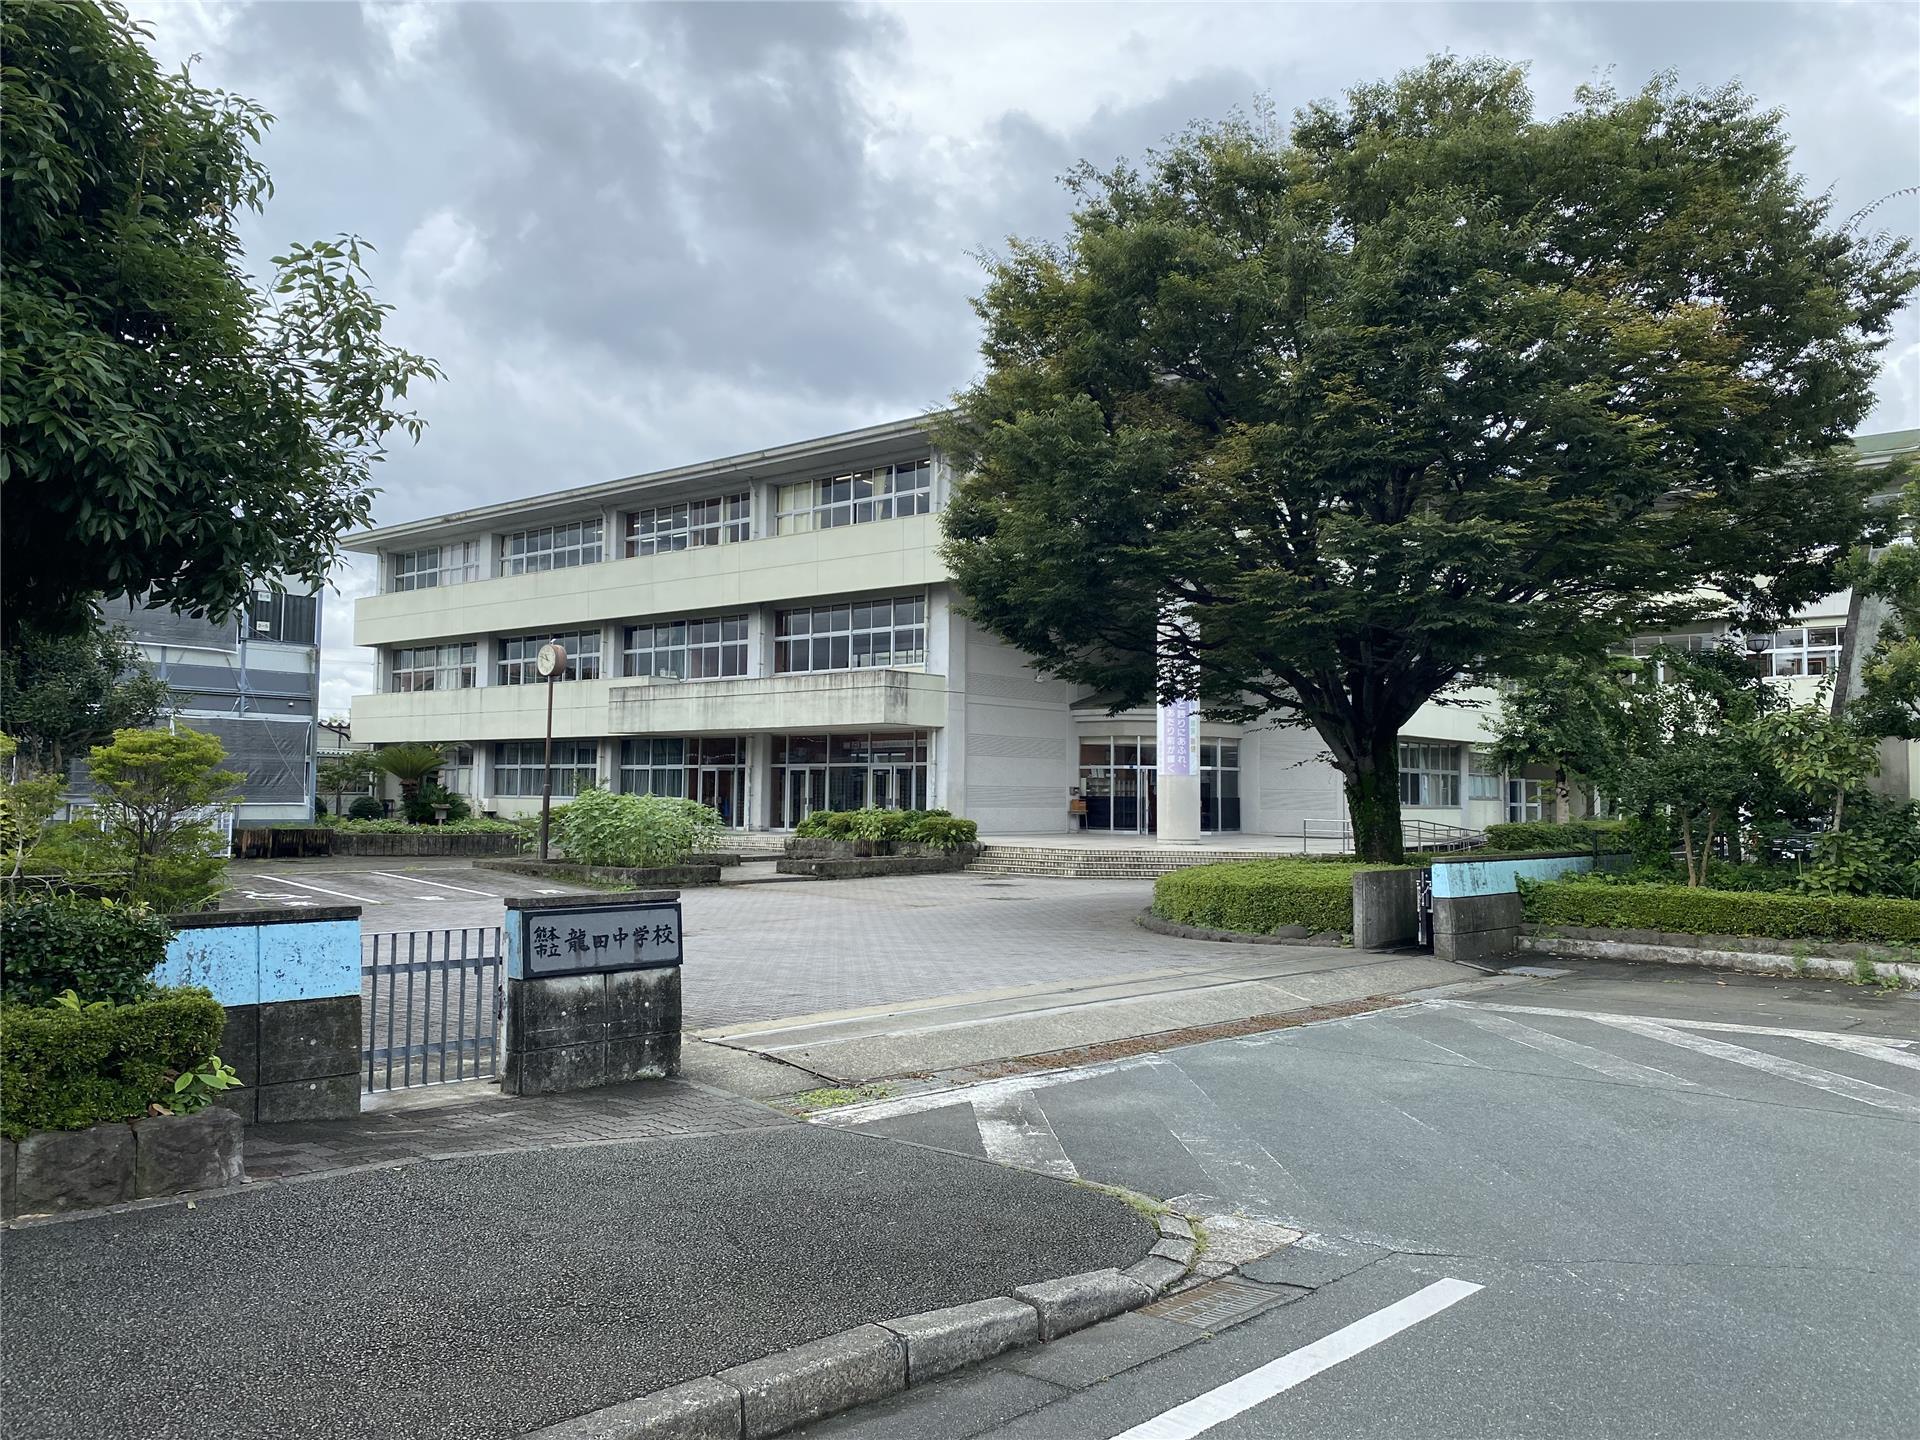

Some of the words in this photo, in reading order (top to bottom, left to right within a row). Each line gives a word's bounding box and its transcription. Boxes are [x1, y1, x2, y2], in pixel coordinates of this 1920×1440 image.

[534, 926, 561, 942] 熊本
[565, 924, 676, 953] 龍田中学校
[534, 943, 562, 958] 市立
